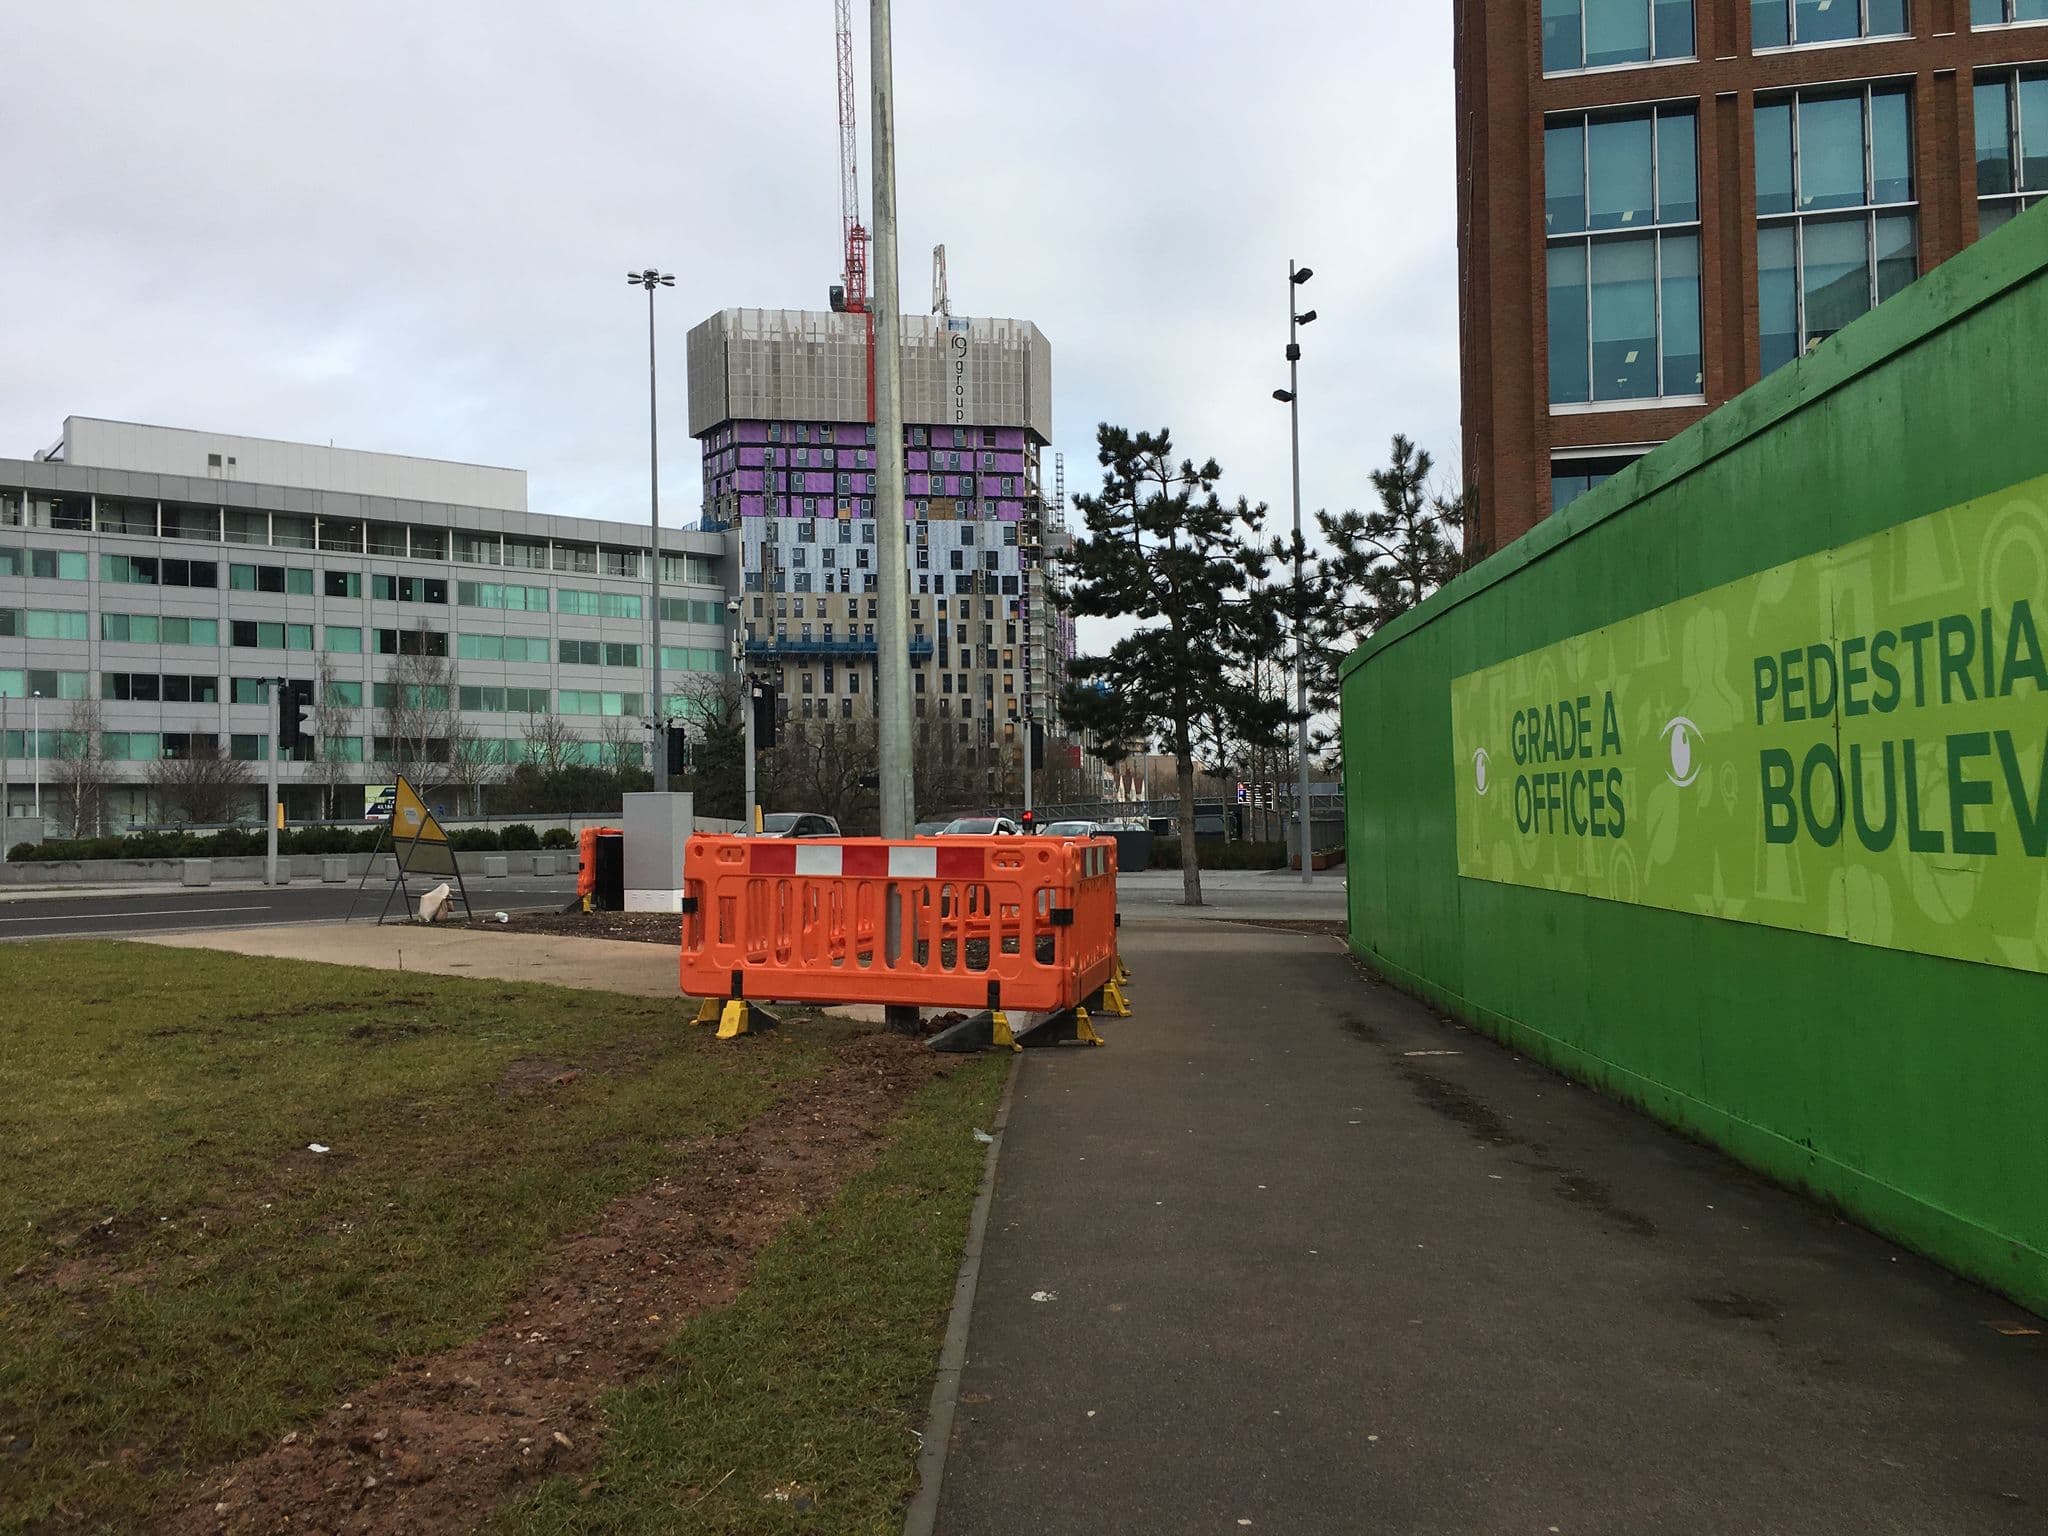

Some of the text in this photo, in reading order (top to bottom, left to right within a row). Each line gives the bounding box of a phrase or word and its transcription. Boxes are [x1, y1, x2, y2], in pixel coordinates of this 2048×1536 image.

[955, 360, 964, 423] group
[1754, 599, 2048, 726] PEDESTRIA
[1512, 691, 1622, 766] GRADE A
[1514, 767, 1626, 839] OFFICES
[1760, 728, 2048, 858] BOULEV
